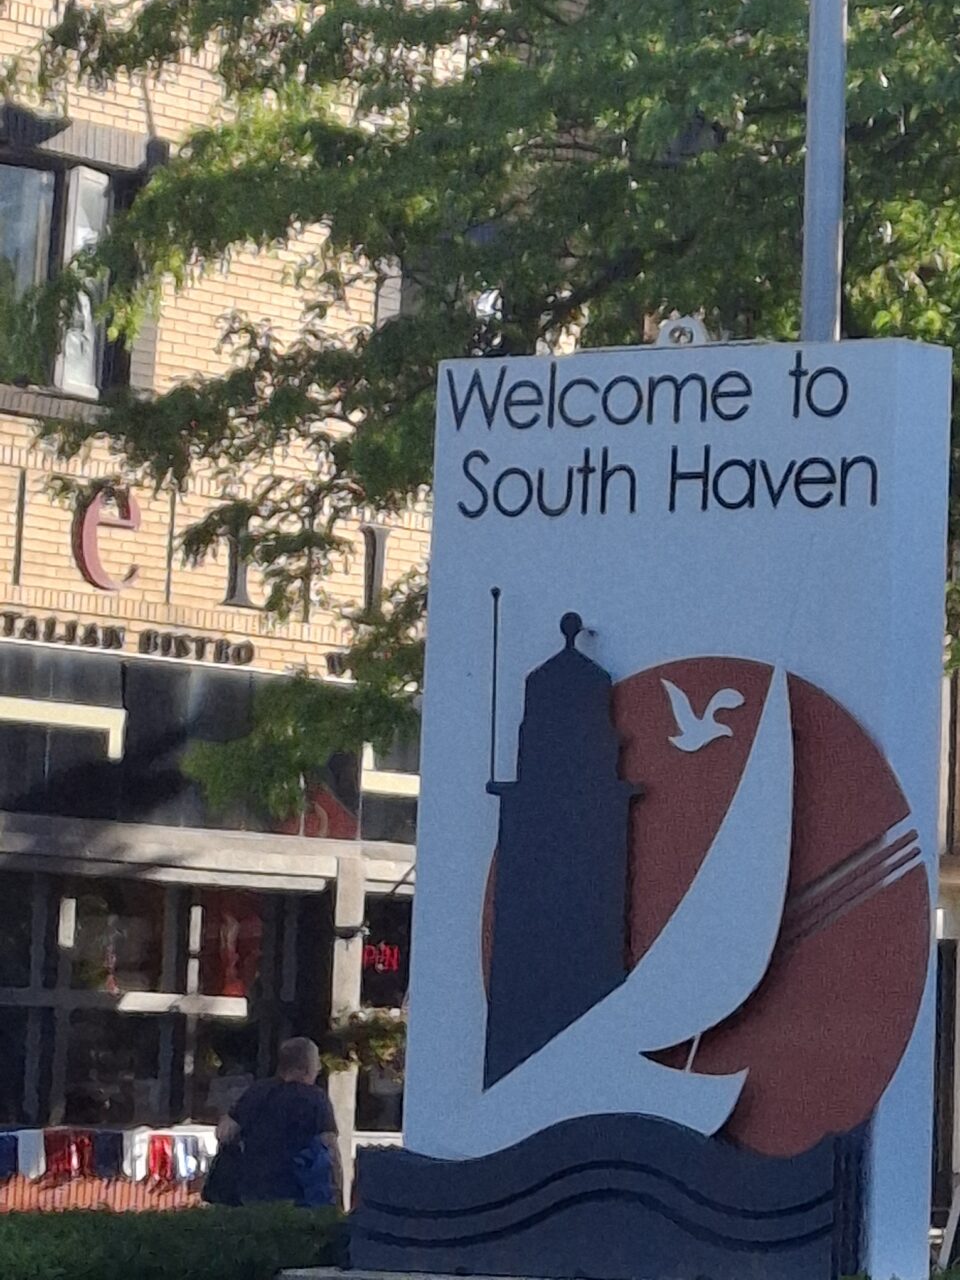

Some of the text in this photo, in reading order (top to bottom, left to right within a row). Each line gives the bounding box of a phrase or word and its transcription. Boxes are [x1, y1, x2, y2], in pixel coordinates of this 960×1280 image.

[446, 349, 849, 432] Welcome to
[457, 443, 879, 519] South Haven
[138, 627, 255, 666] BISTRO
